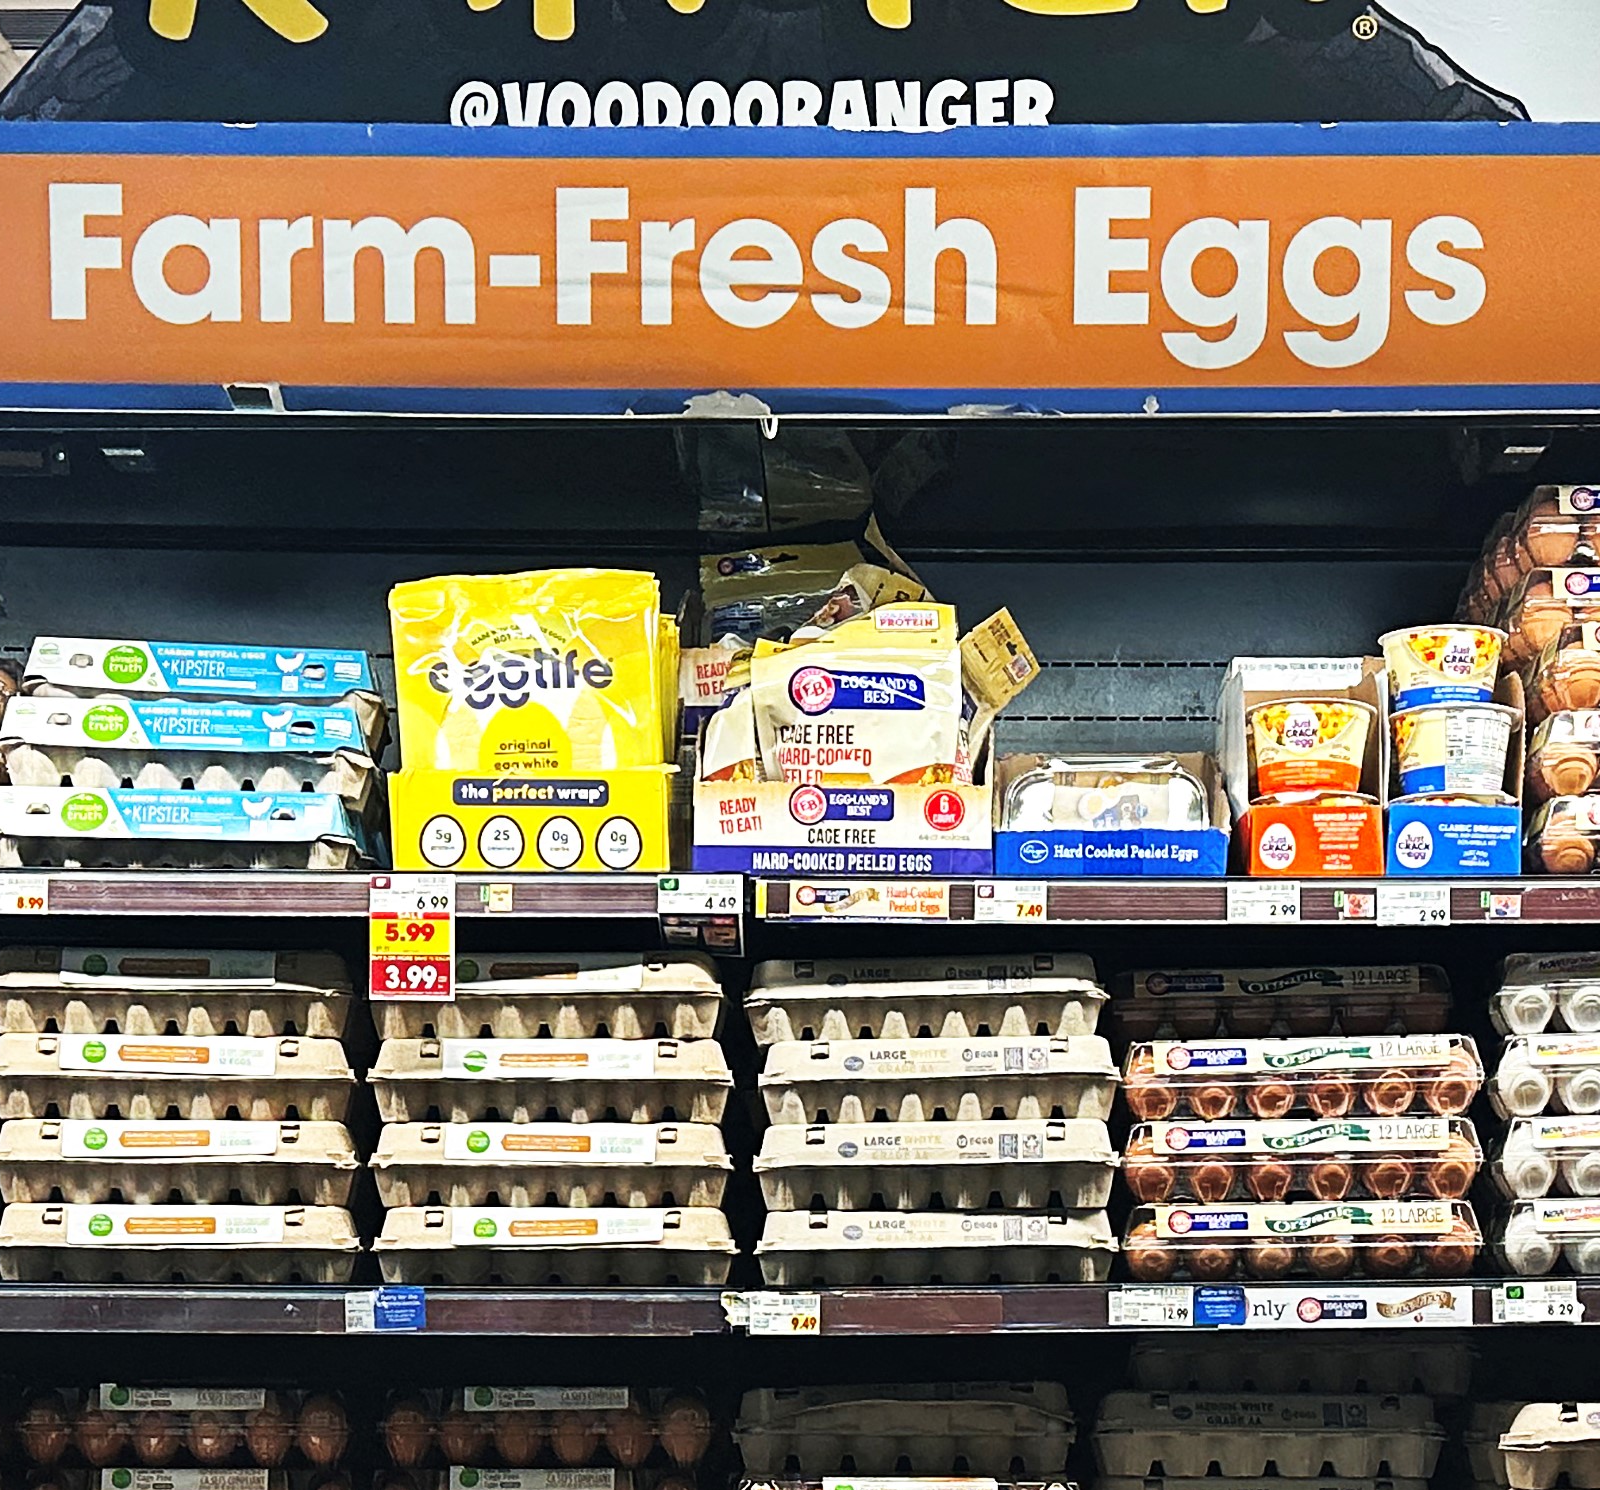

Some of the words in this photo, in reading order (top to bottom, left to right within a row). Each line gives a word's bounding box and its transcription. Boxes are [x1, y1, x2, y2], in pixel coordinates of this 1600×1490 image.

[450, 80, 1056, 127] @VOODOORANGER
[47, 181, 998, 327] Farm-Fresh
[1072, 186, 1488, 371] Eggs
[697, 662, 731, 680] READY
[1291, 719, 1312, 731] Just
[781, 725, 812, 745] CAGE
[816, 725, 855, 745] FREE
[1285, 730, 1318, 739] CRACK
[500, 739, 550, 753] original
[461, 784, 489, 800] the
[492, 783, 554, 803] perfect
[719, 797, 757, 815] READY
[719, 819, 735, 835] TO
[737, 816, 763, 833] EAT!
[435, 829, 452, 844] 5g
[493, 829, 511, 841] 25
[552, 830, 569, 845] 0g
[610, 830, 627, 846] 0g
[808, 828, 840, 845] CAGE
[844, 828, 875, 845] FREE
[1053, 844, 1084, 859] Hard
[1084, 844, 1128, 859] Cooked
[1130, 844, 1169, 859] Peeled
[1170, 845, 1199, 863] Eggs
[752, 853, 844, 871] HARD-COOKED
[847, 853, 896, 871] PEELED
[900, 855, 933, 872] EGGS
[16, 897, 43, 910] 8.99
[1017, 904, 1043, 918] 7.49
[385, 923, 435, 943] 5.99
[385, 965, 437, 989] 3.99
[869, 1050, 907, 1061] LARGE
[1396, 1123, 1441, 1140] LARGE
[791, 1317, 817, 1331] 9.49
